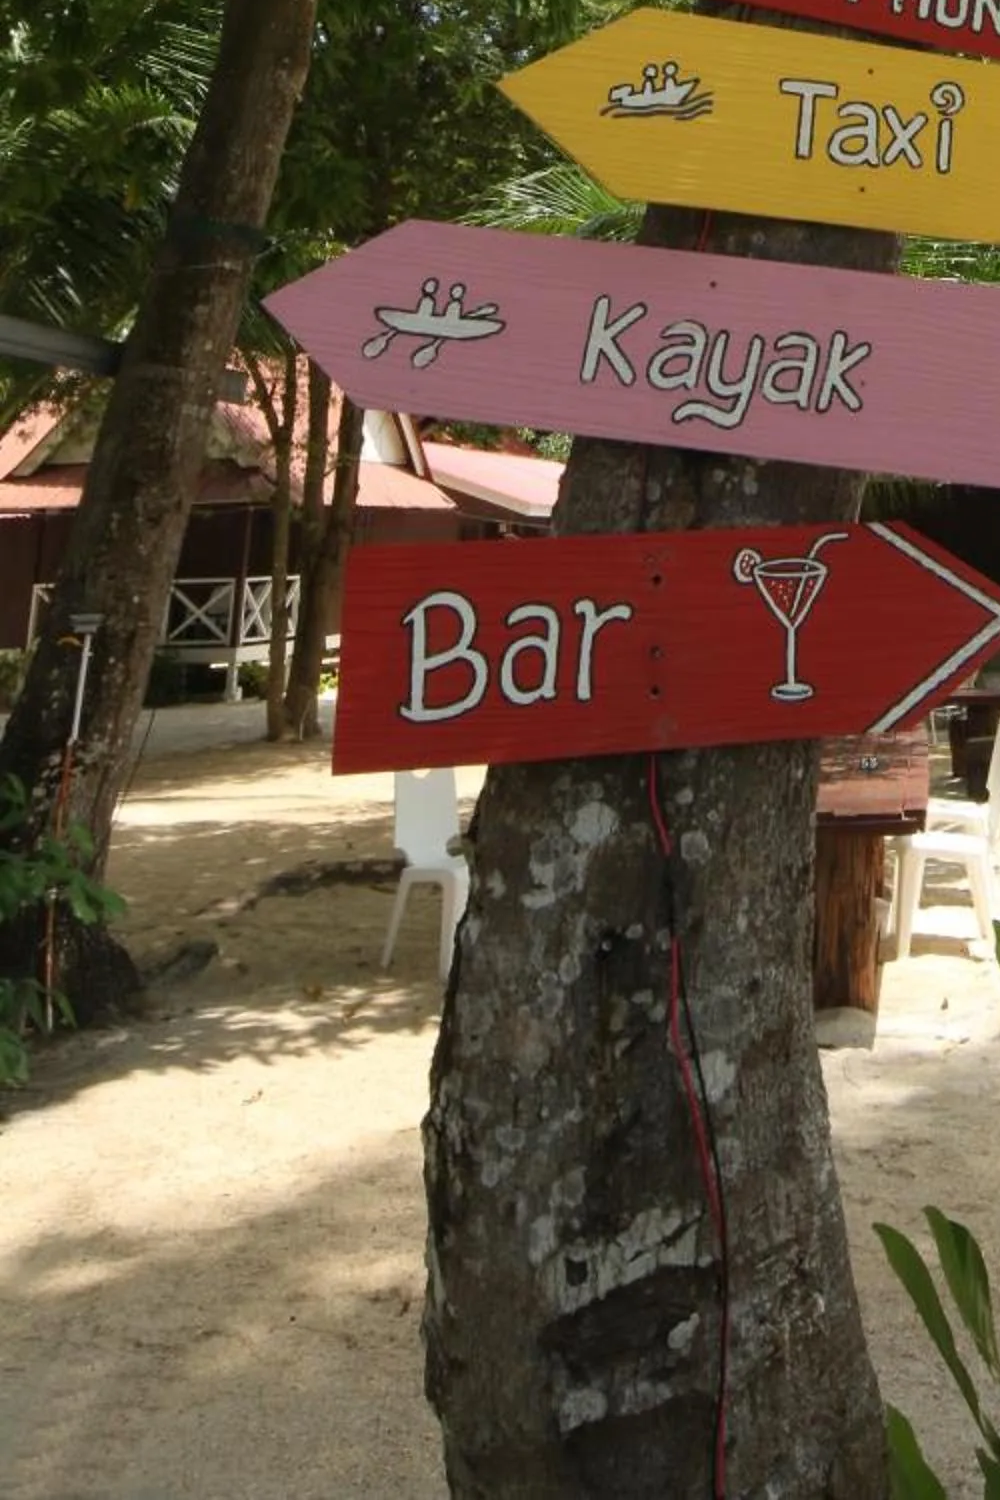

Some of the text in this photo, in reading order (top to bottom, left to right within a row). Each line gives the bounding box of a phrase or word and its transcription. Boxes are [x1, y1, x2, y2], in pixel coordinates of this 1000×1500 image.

[779, 81, 965, 173] Taxi
[580, 295, 872, 429] Kayak
[399, 591, 633, 723] Bar
